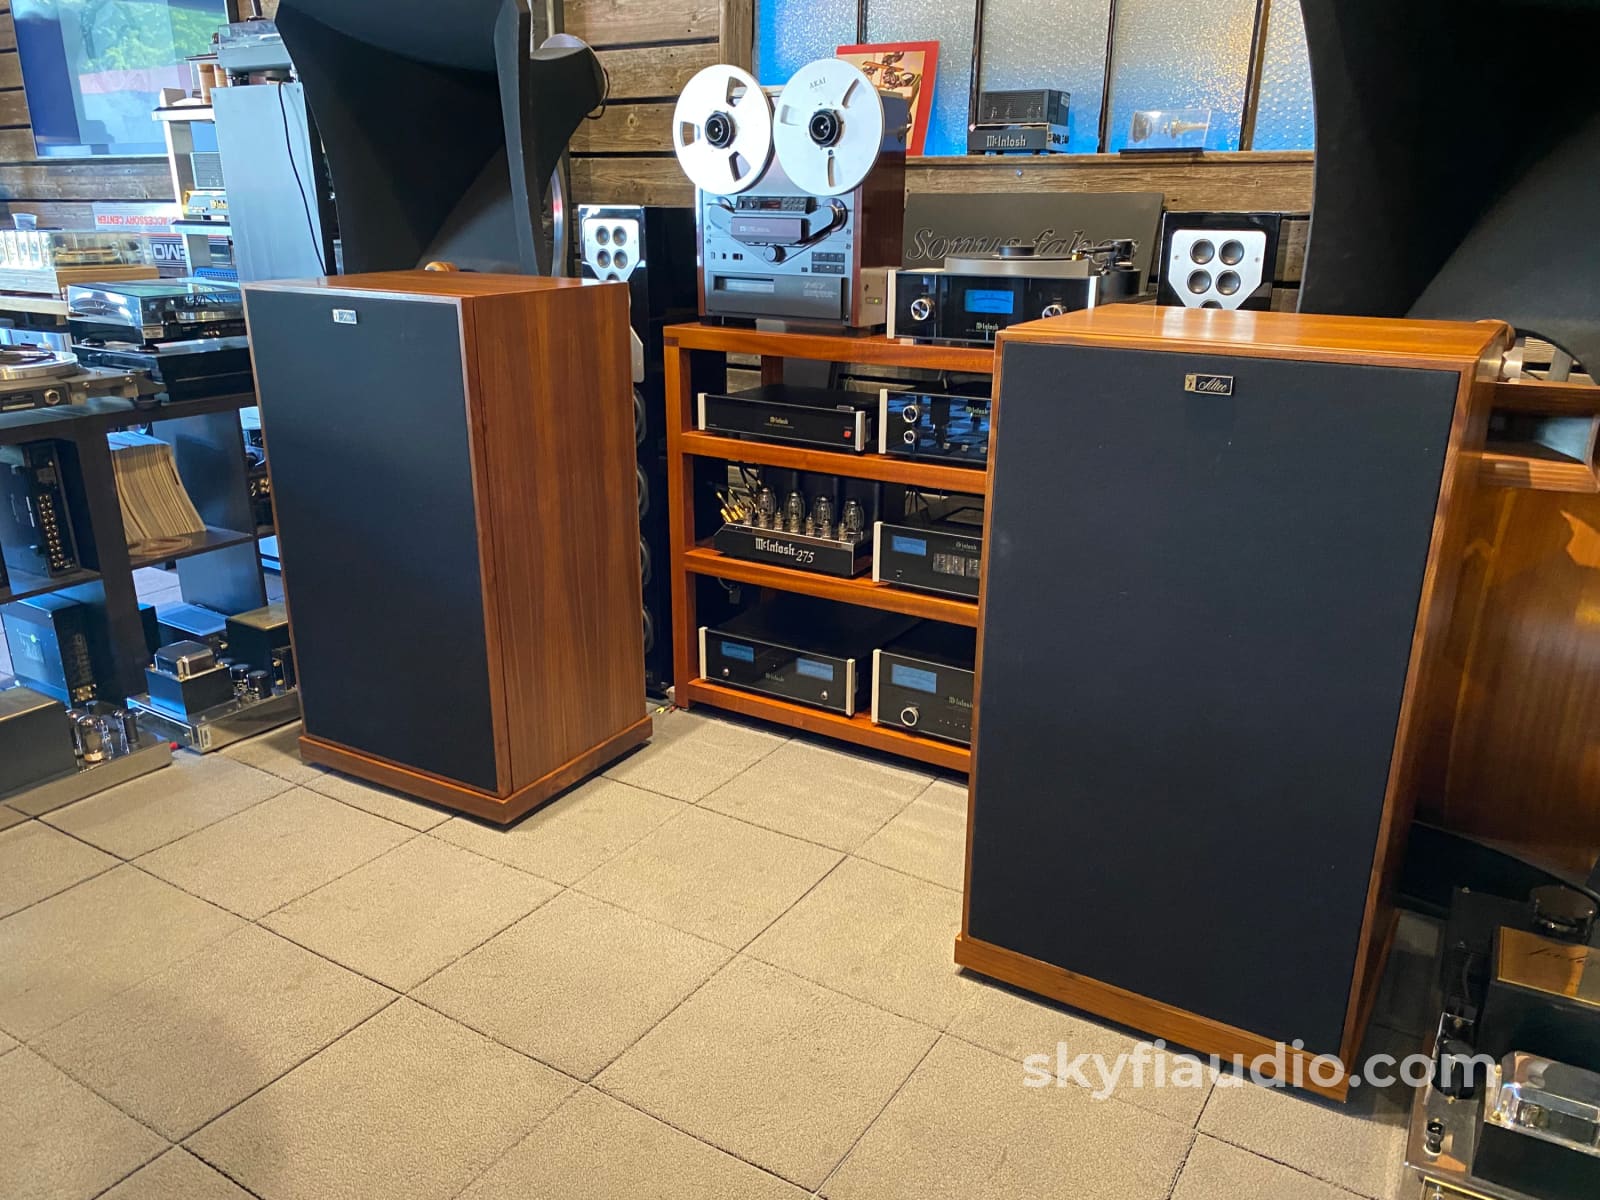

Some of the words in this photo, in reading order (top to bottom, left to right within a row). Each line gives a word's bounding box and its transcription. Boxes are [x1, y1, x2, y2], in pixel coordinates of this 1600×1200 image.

[809, 76, 826, 88] AKAI
[986, 134, 1026, 147] McIntosh
[97, 215, 123, 225] CENTER
[126, 215, 167, 226] ACCESSORY
[755, 537, 795, 556] McIntosh
[796, 549, 815, 564] 275
